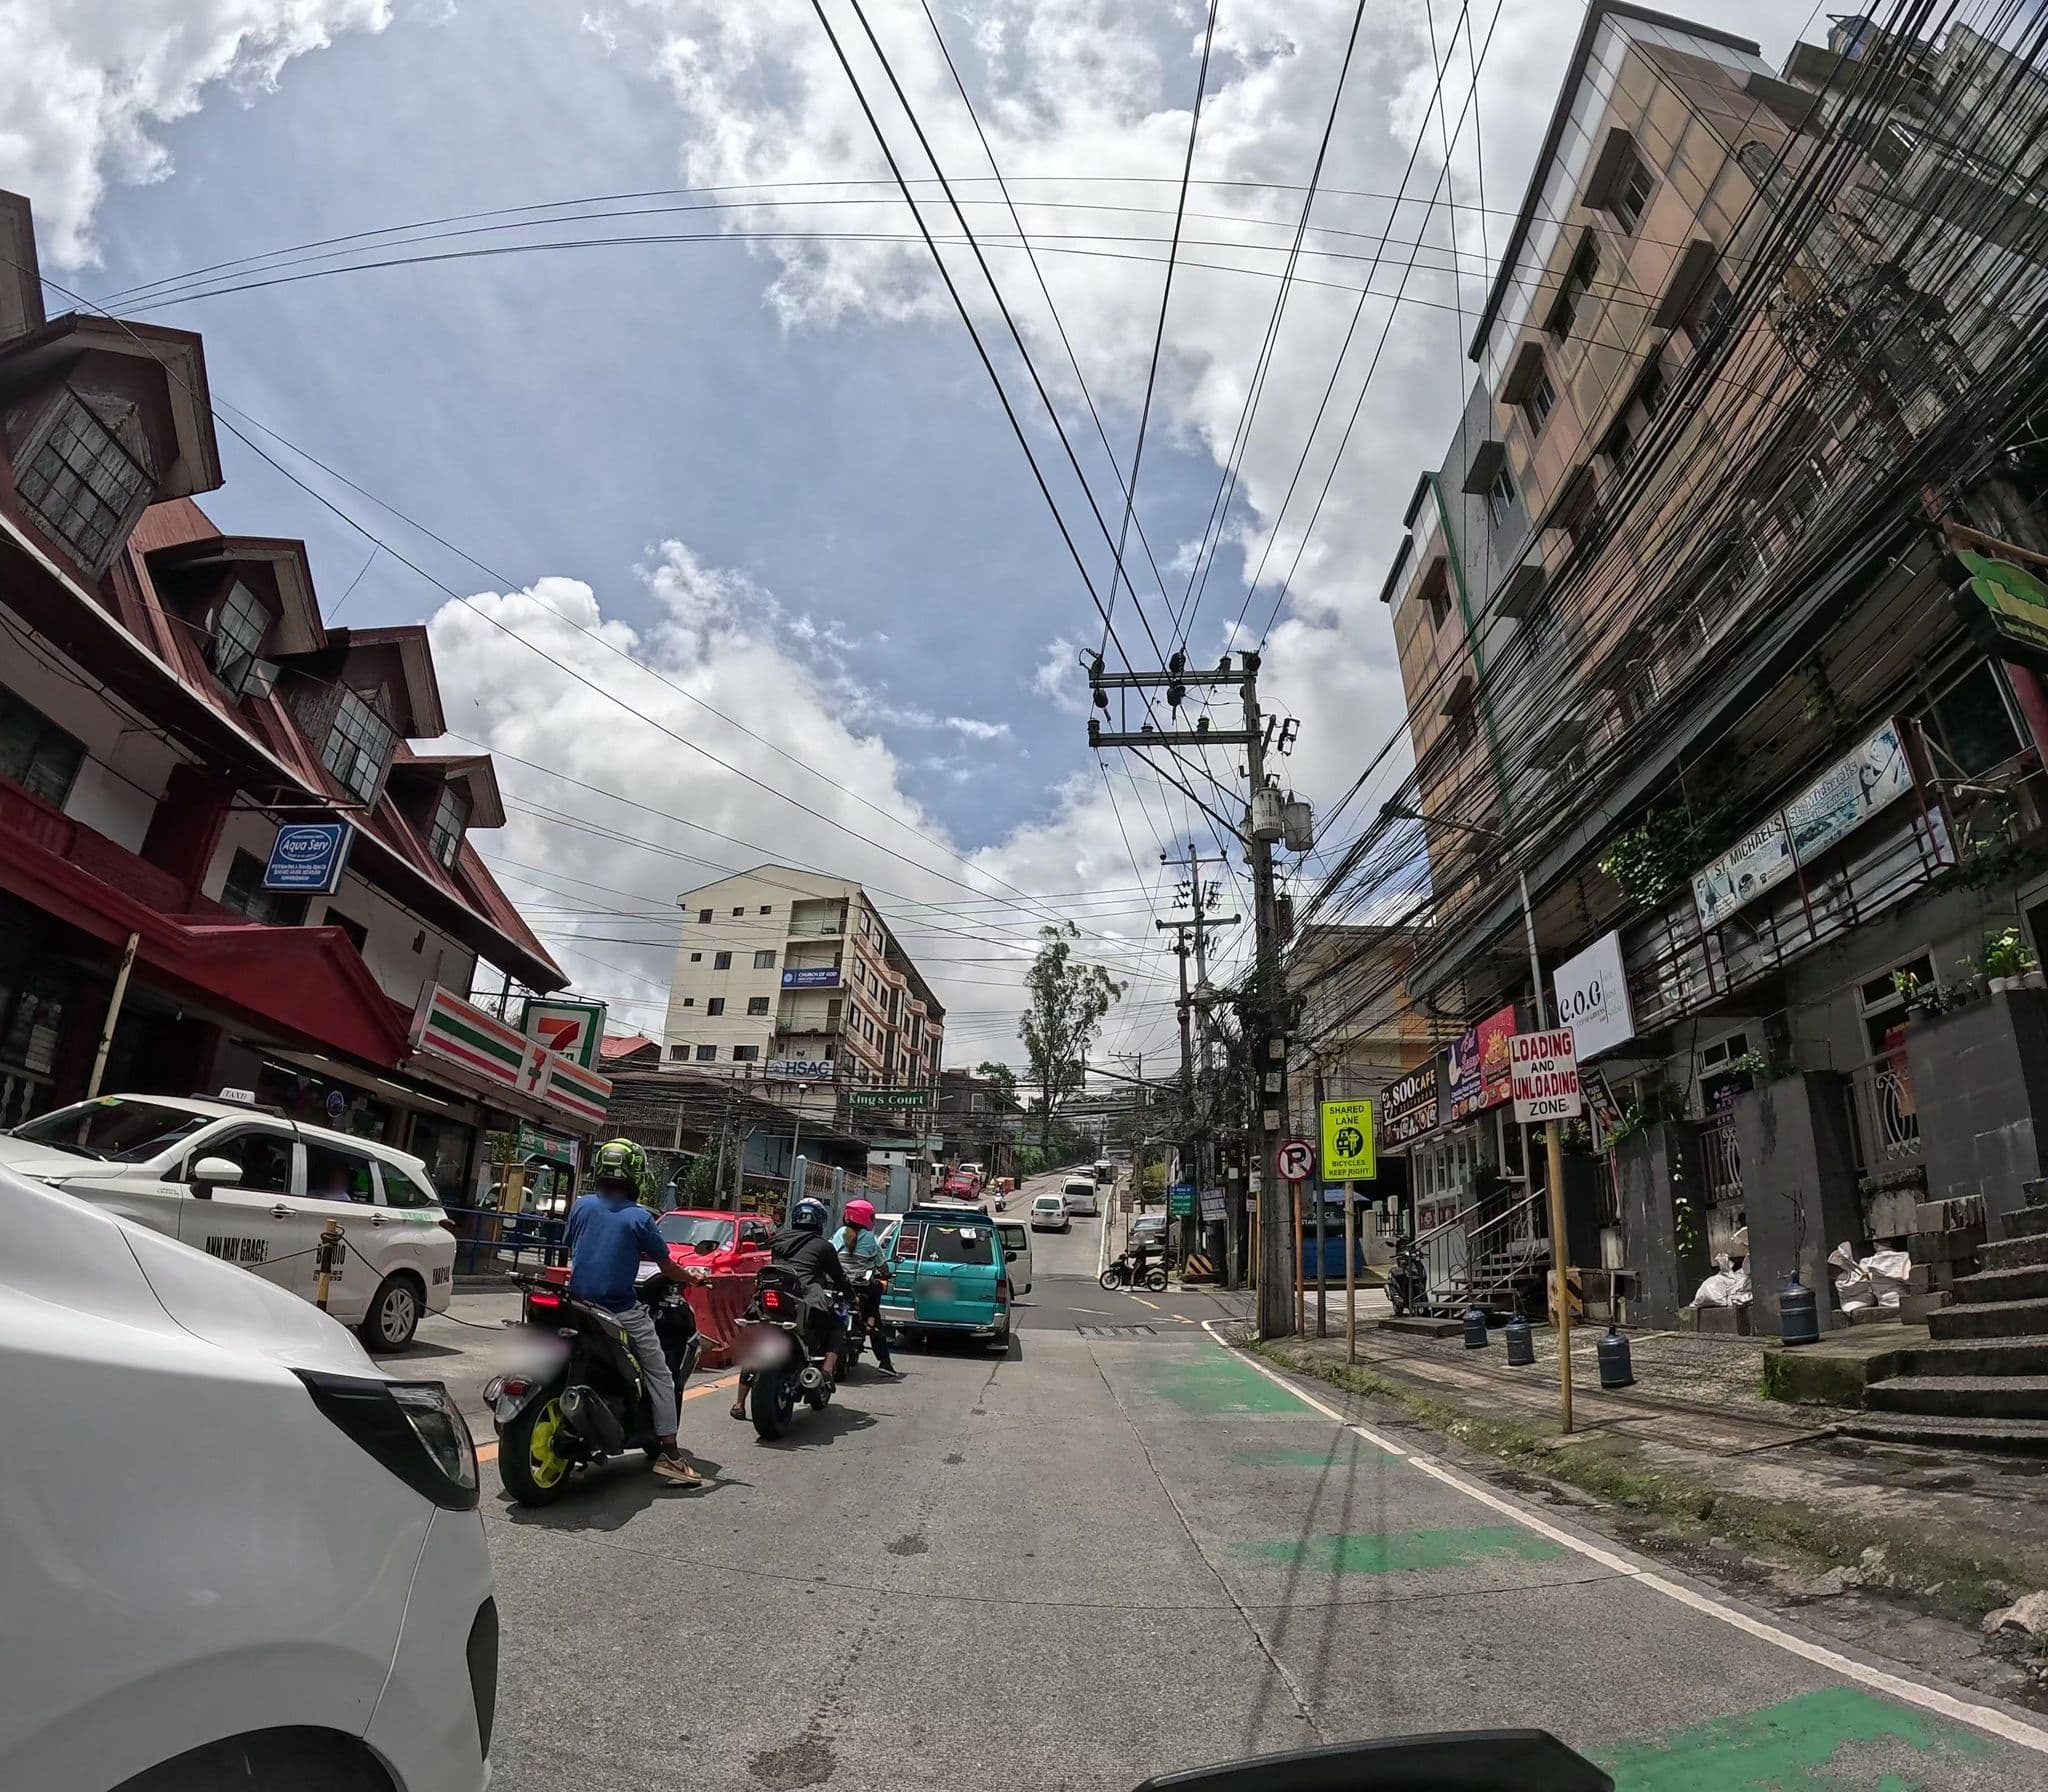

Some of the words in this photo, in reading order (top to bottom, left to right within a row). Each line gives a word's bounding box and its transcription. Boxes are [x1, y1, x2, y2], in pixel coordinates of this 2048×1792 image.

[1804, 761, 1858, 810] Michael's
[282, 839, 307, 853] Aqua
[307, 839, 329, 850] Serv
[1714, 859, 1729, 877] ST.
[1729, 818, 1782, 866] MICHAEL'S
[1560, 980, 1601, 1023] C.O.G
[1511, 1032, 1572, 1063] LOADING
[785, 1061, 829, 1075] HSAC
[1530, 1060, 1555, 1074] AND
[1415, 1069, 1436, 1093] CAFE
[1514, 1070, 1578, 1101] UNLOADING
[849, 1092, 885, 1106] King's
[888, 1095, 924, 1105] Court
[1529, 1099, 1567, 1117] ZONE
[1329, 1105, 1364, 1115] SHARED
[1335, 1116, 1359, 1125] LANE
[1331, 1159, 1366, 1167] BICYCLES
[1348, 1168, 1370, 1176] RIGHT
[205, 1236, 222, 1260] ANN
[223, 1237, 240, 1262] MAY
[240, 1238, 265, 1262] GRACE
[316, 1244, 346, 1265] BUIO
